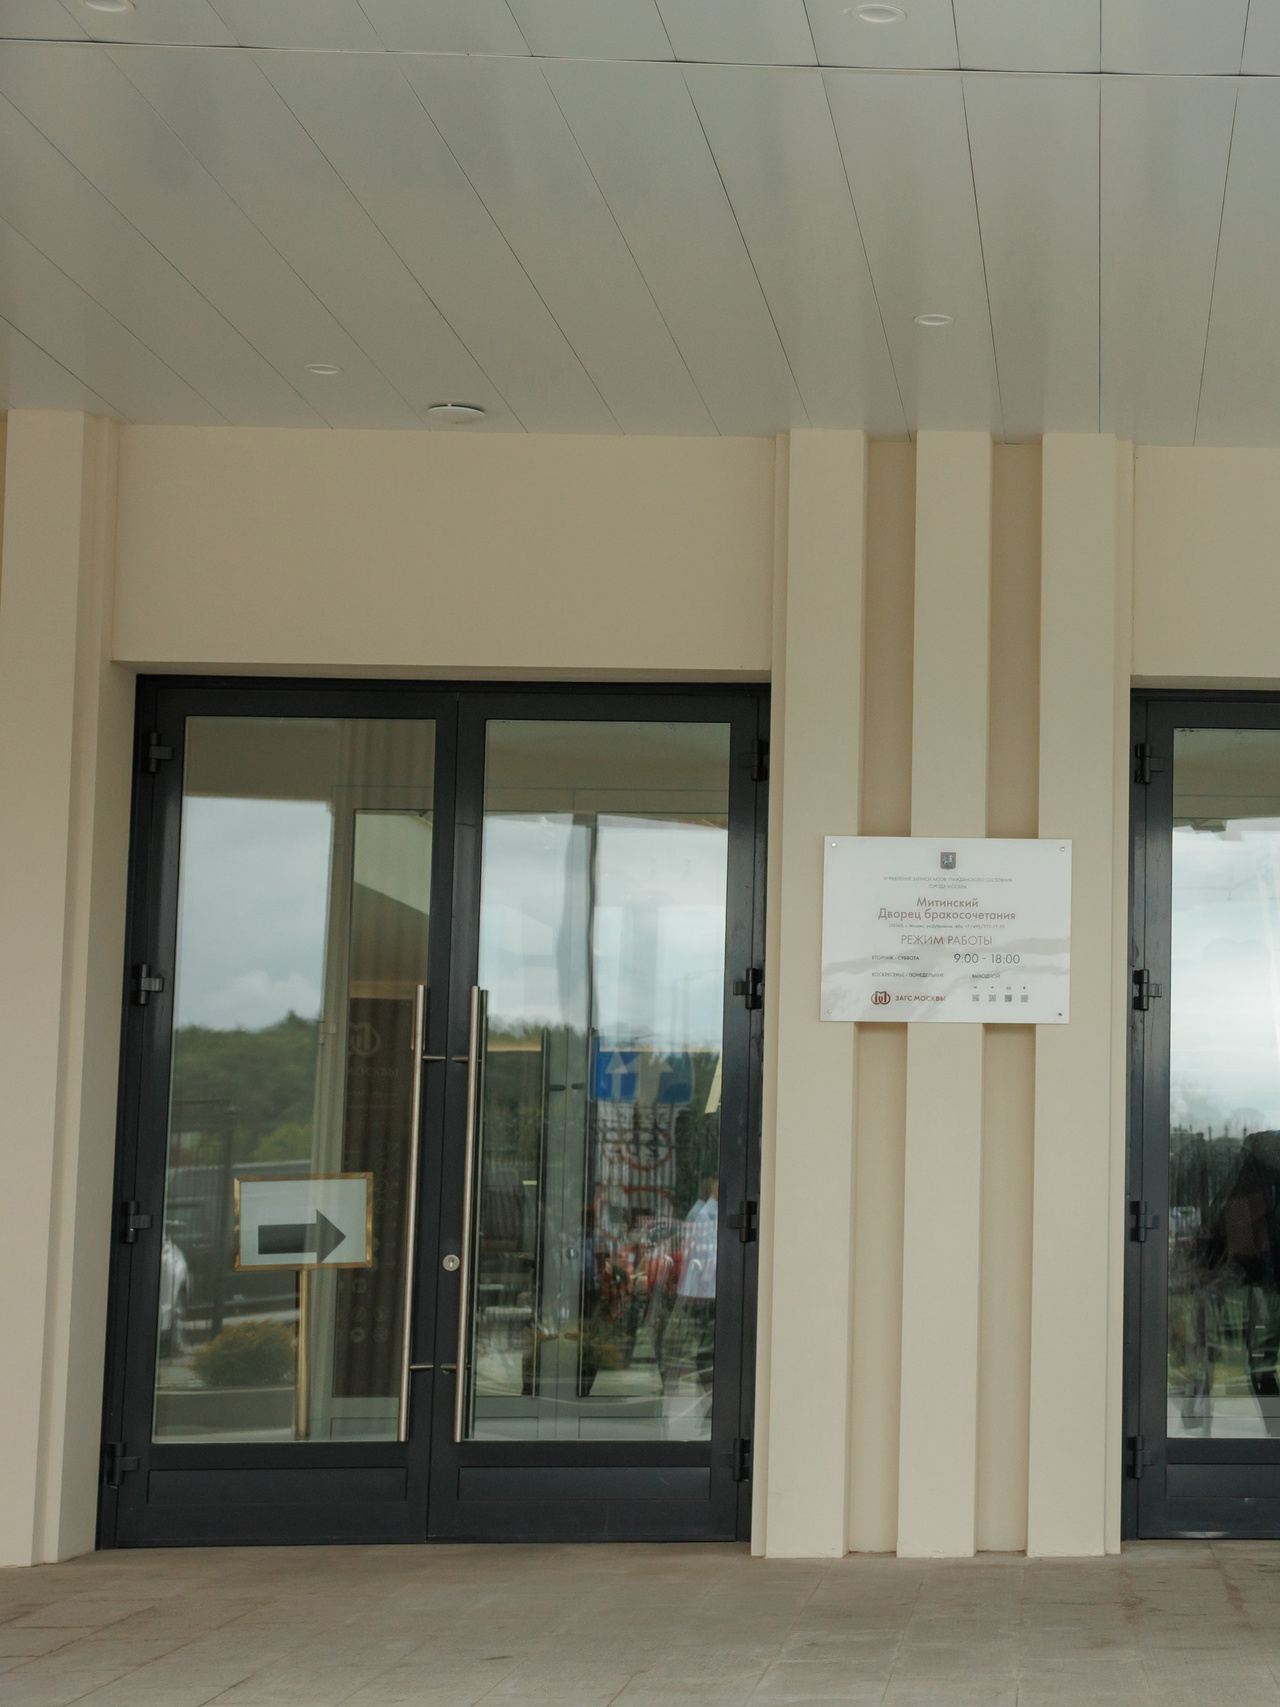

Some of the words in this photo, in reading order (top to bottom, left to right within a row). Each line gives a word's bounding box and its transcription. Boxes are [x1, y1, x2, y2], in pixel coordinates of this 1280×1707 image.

[916, 897, 979, 908] Митинский
[877, 907, 921, 921] Дворец
[924, 908, 1016, 921] бракосочетания
[901, 934, 944, 945] РЕЖИМ
[947, 935, 993, 946] РАБОТЫ
[953, 953, 979, 964] 9:00
[990, 954, 1020, 965] 18:00
